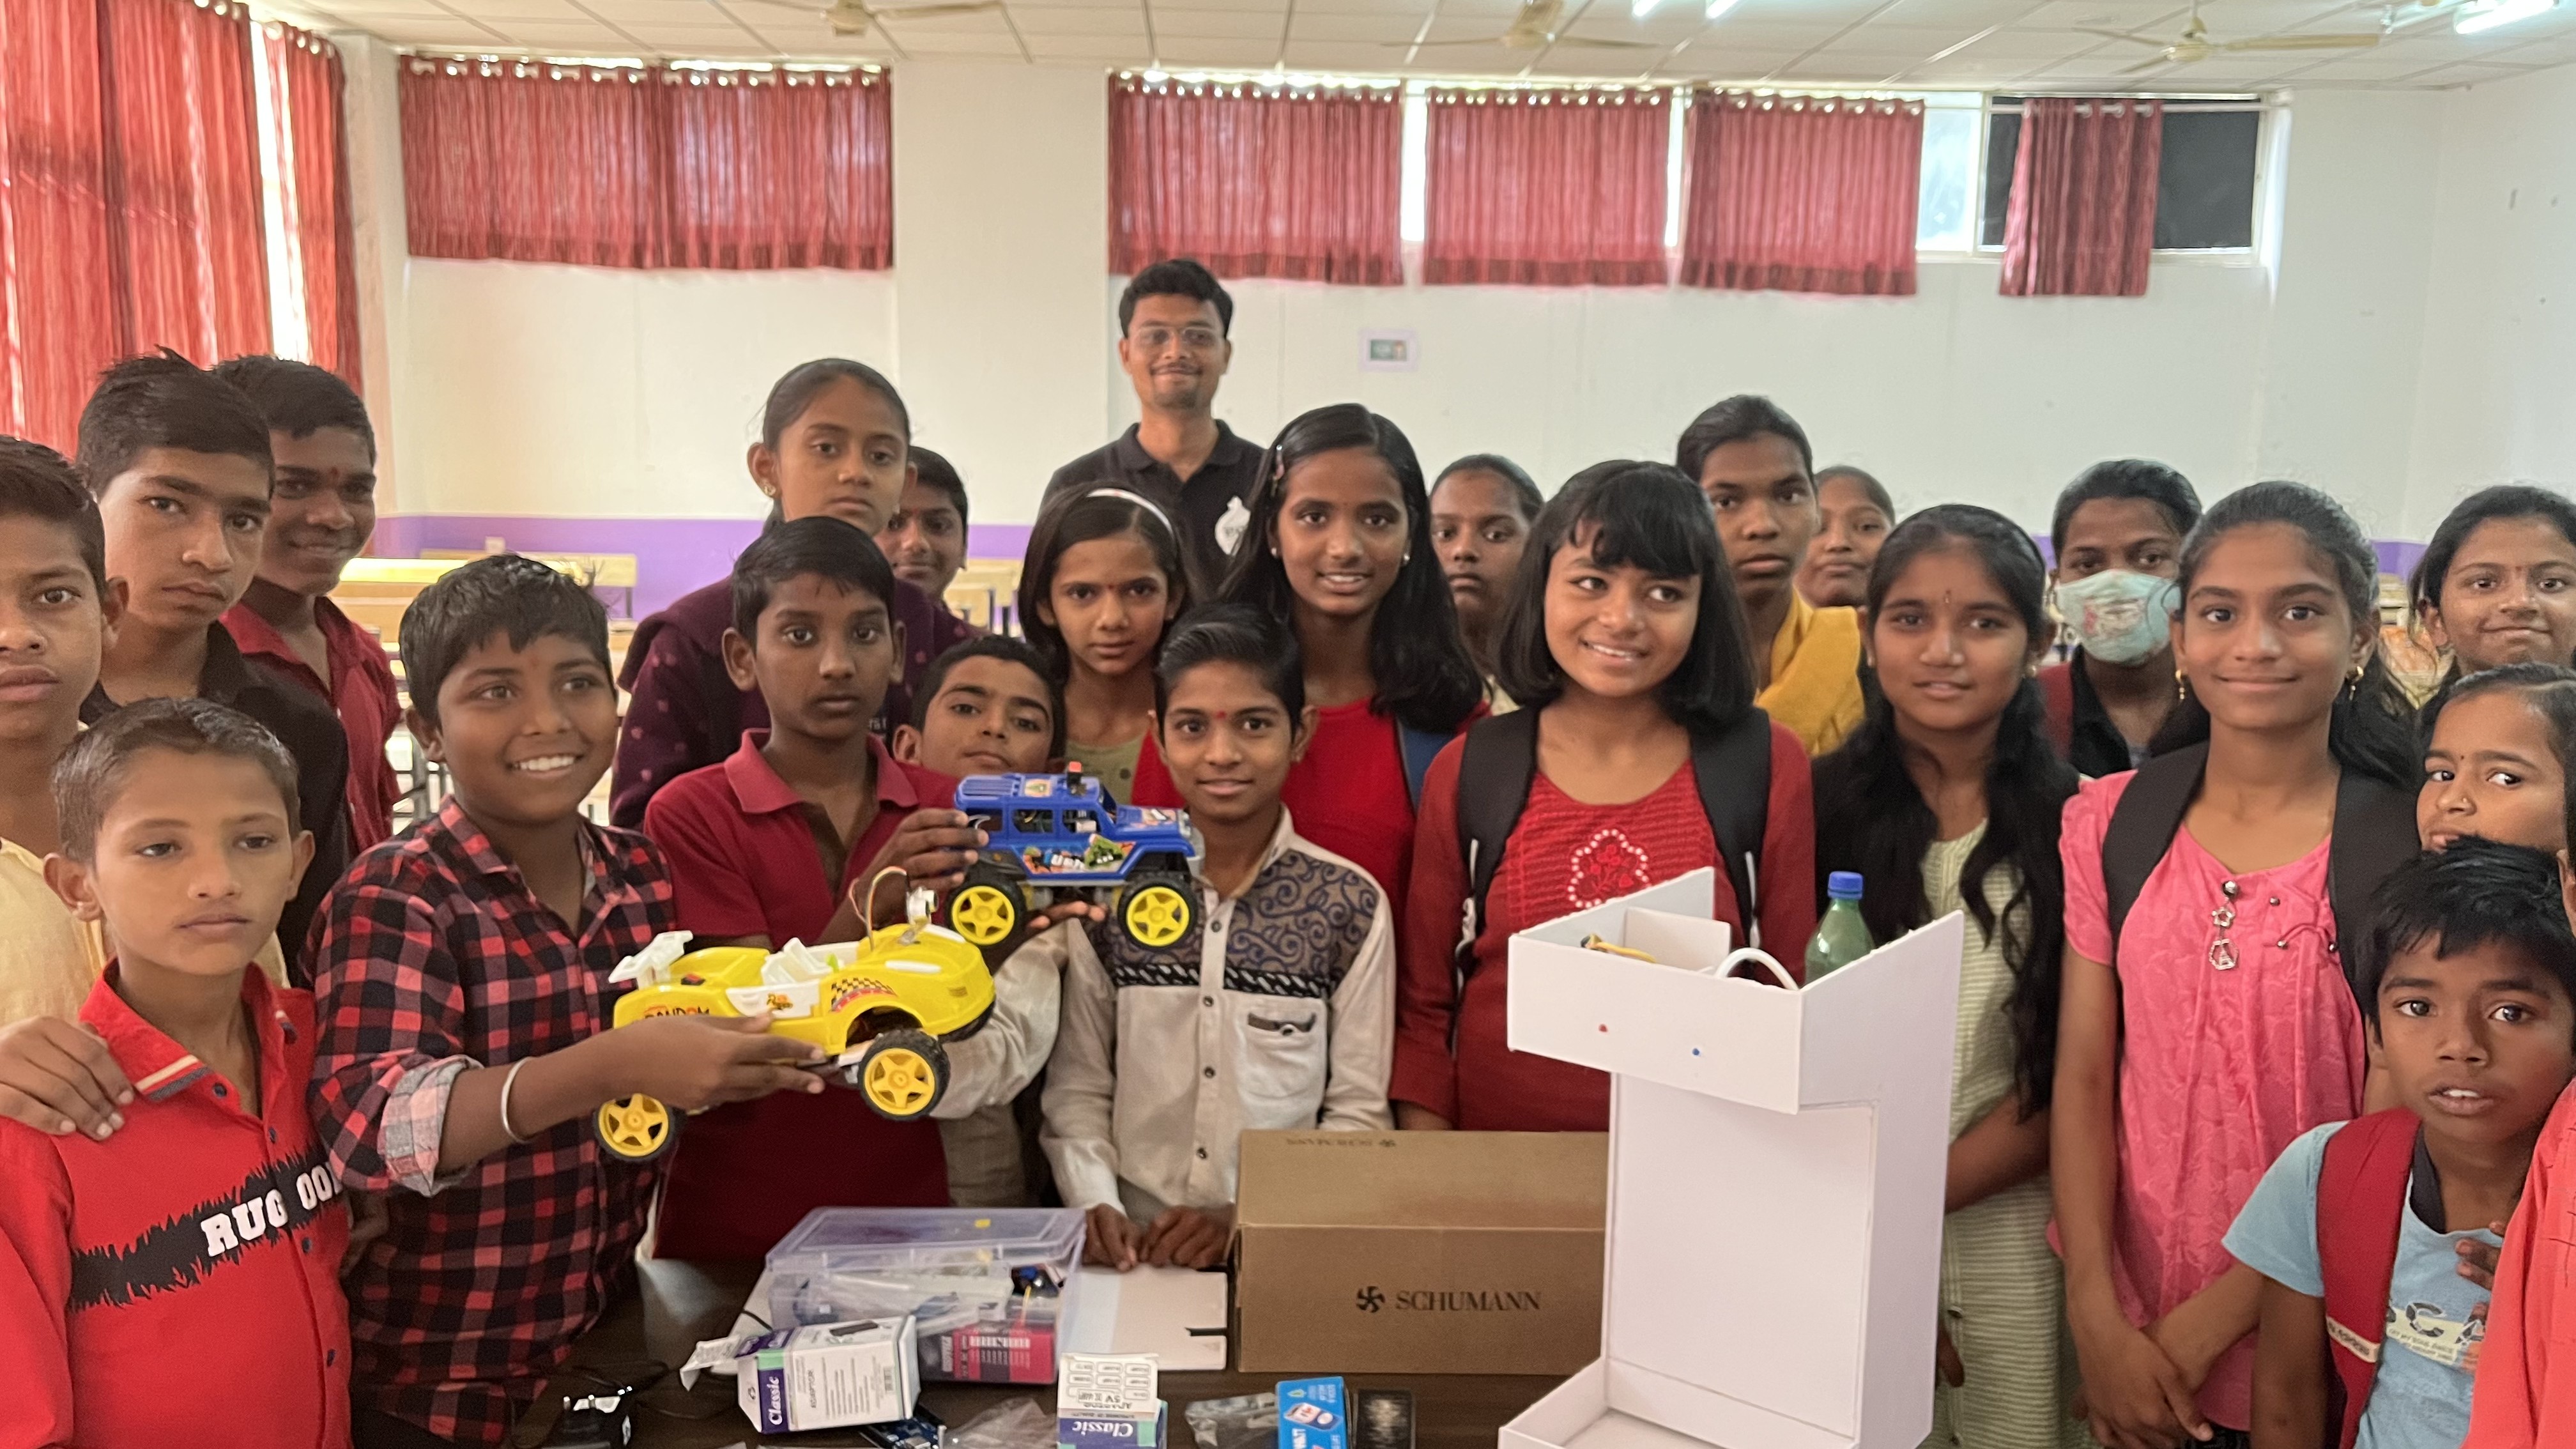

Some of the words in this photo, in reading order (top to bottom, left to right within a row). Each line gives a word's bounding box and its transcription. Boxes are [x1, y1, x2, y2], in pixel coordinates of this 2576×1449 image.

[1395, 1290, 1540, 1311] SCHUMANN
[767, 1376, 783, 1425] Classic
[1072, 1421, 1133, 1438] Classic
